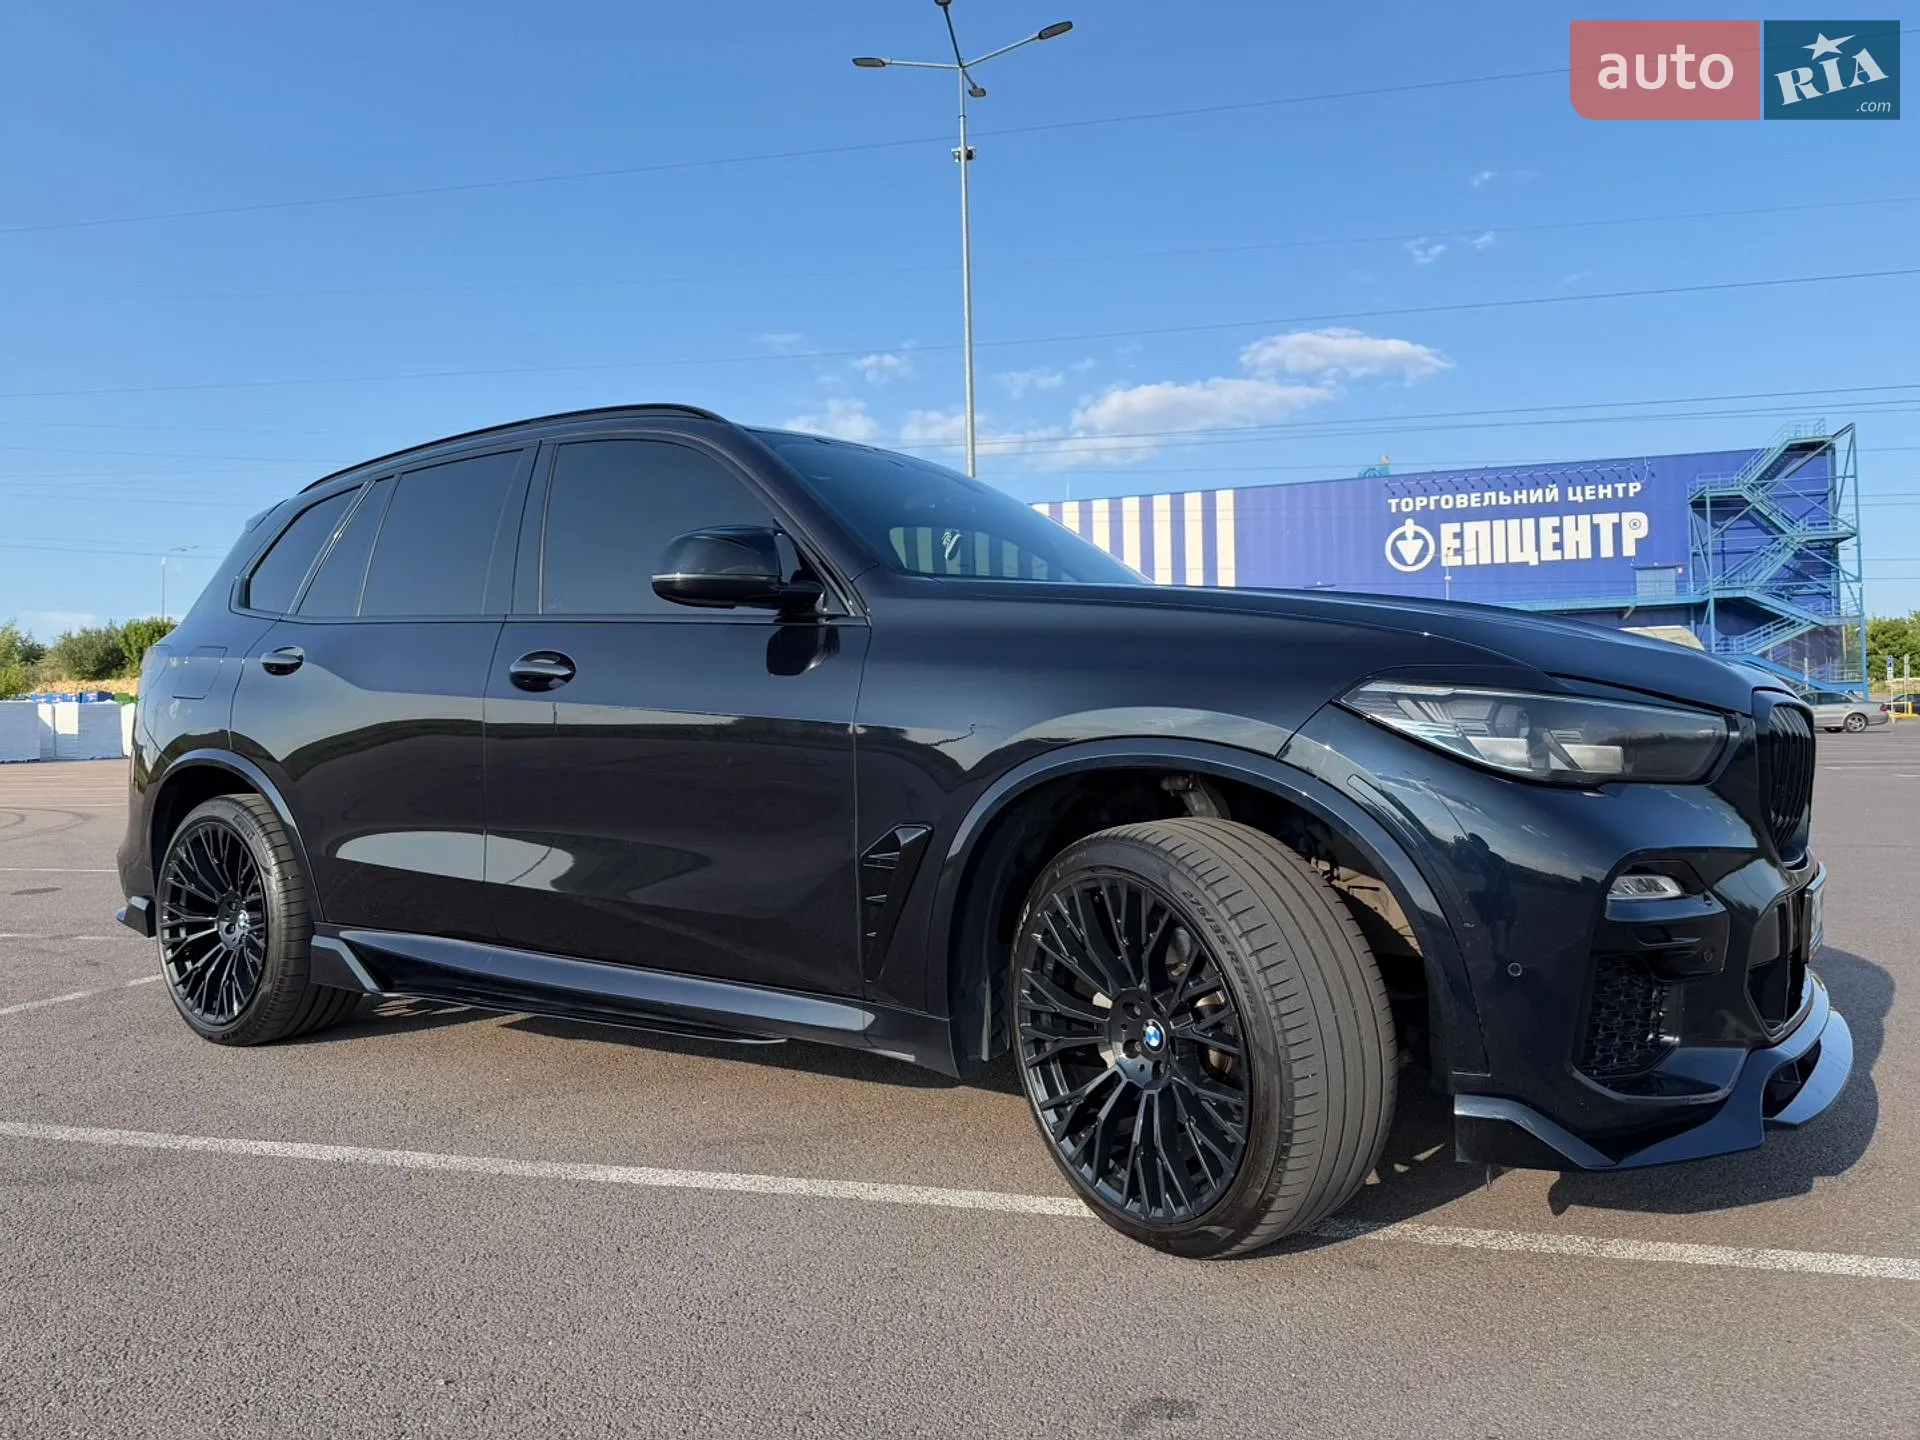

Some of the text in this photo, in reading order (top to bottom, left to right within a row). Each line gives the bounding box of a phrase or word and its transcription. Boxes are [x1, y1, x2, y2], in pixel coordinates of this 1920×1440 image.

[1387, 482, 1642, 513] ТОРГОВЕЛЬНИЙ ЦЕНТР
[1440, 511, 1649, 567] ЕПІЦЕНТР
